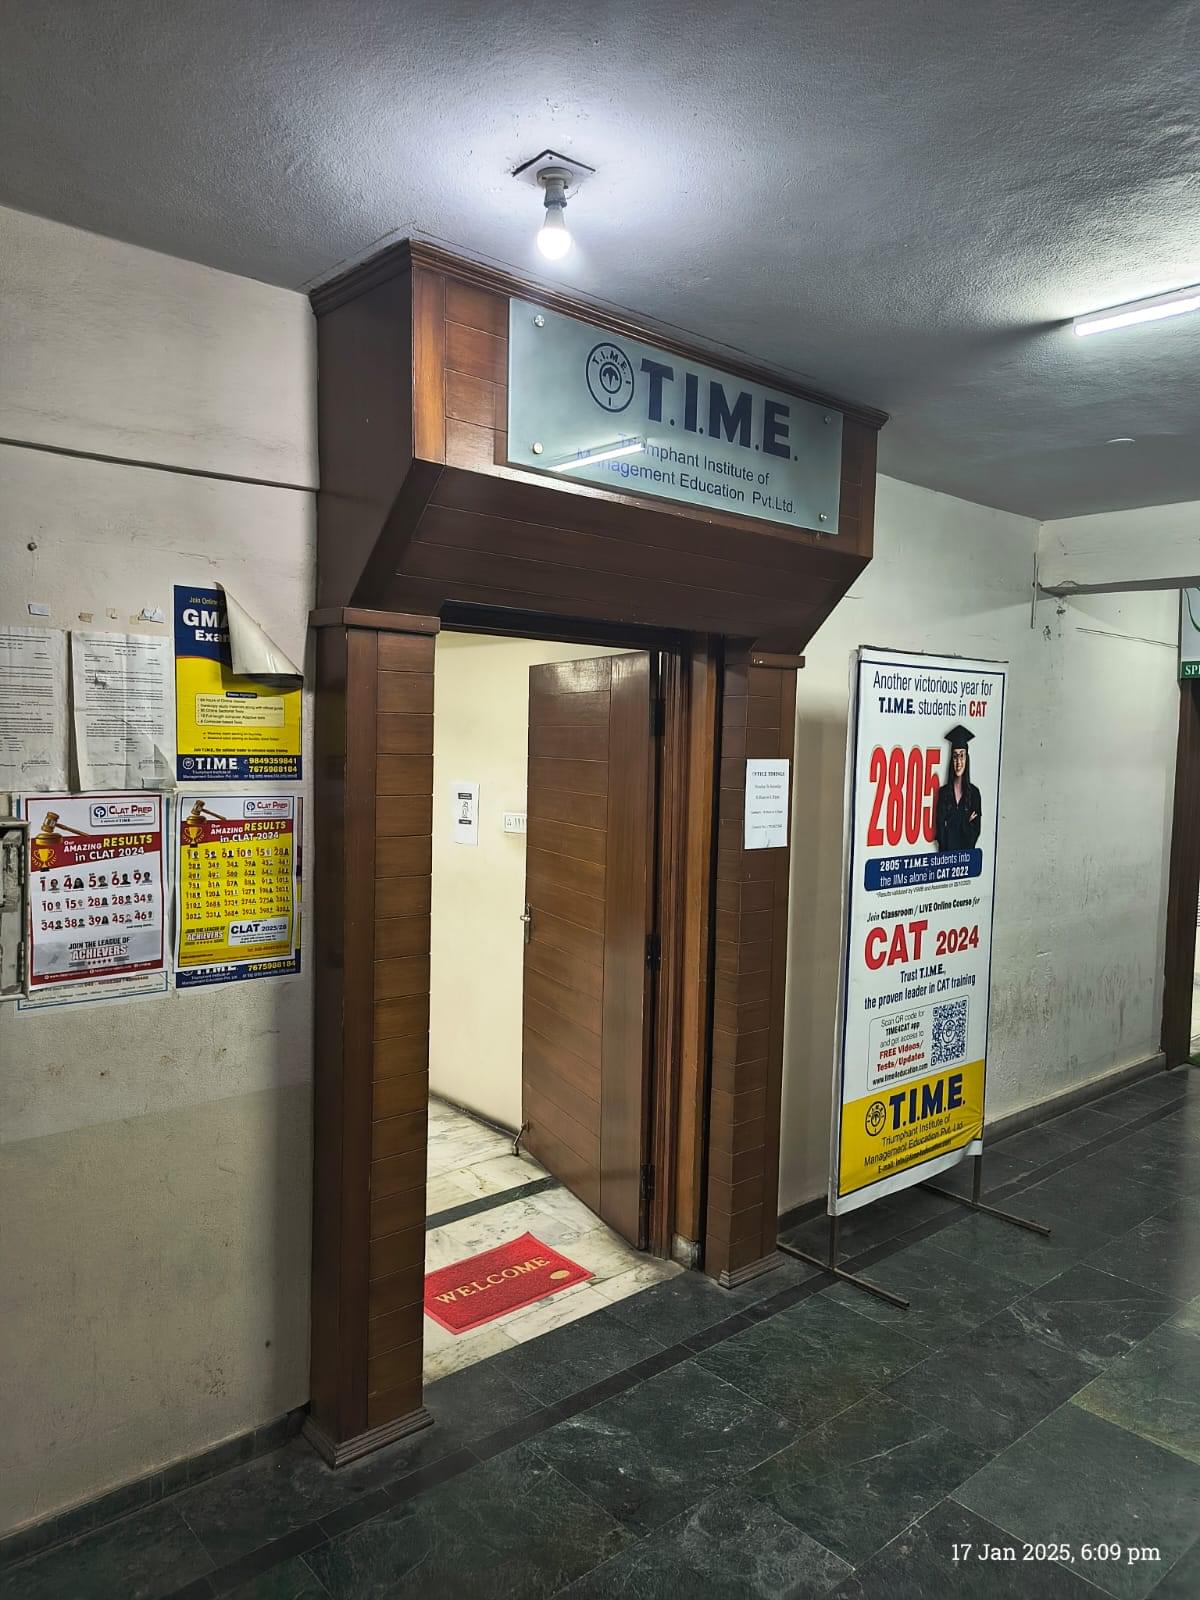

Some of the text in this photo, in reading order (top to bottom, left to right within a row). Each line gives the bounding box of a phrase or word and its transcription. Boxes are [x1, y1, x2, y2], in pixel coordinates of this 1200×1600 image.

[640, 358, 798, 461] T.I.M.E.
[577, 447, 676, 487] Mnagement
[680, 474, 744, 502] Education
[703, 456, 754, 485] Institute
[757, 472, 770, 486] of
[873, 671, 993, 699] Another victorious year for
[878, 697, 988, 717] T.I.M.E. students in CAT
[195, 757, 240, 771] T.I.M.E.
[866, 746, 941, 847] 2805
[211, 821, 287, 835] AMAZING RESULTS
[220, 832, 279, 843] in CLAT 2024
[64, 835, 153, 852] AMAZING RESULTS
[75, 846, 145, 862] in CLAT 2024
[931, 854, 957, 866] students
[958, 852, 971, 863] into
[40, 872, 142, 892] 1 4 5 6 9
[880, 875, 892, 887] the
[909, 871, 928, 883] alone
[928, 870, 935, 881] in
[936, 867, 951, 879] CAT
[951, 865, 969, 878] 2022
[42, 894, 146, 911] 10 15 28 28 34
[880, 907, 914, 920] Classroom
[919, 902, 933, 914] LIVE
[933, 901, 952, 912] Online
[952, 898, 972, 908] Course
[972, 896, 981, 907] for
[42, 911, 147, 931] 34 38 39 45 46
[230, 924, 261, 934] CLAT
[68, 942, 84, 950] JOIN
[85, 940, 97, 948] THE
[98, 937, 121, 946] LEAGUE
[71, 945, 128, 961] ACHIEVERS
[865, 919, 980, 971] CAT 2024
[900, 968, 918, 984] Trust
[864, 974, 976, 1011] the proven leader in CAT training
[880, 1037, 891, 1049] and
[880, 1046, 897, 1060] FREE
[889, 1073, 966, 1130] T.I.M.E.
[882, 1112, 951, 1147] Triumphant Institute of
[864, 1144, 908, 1168] Management
[908, 1131, 941, 1150] Education
[434, 1256, 550, 1304] WELCOME
